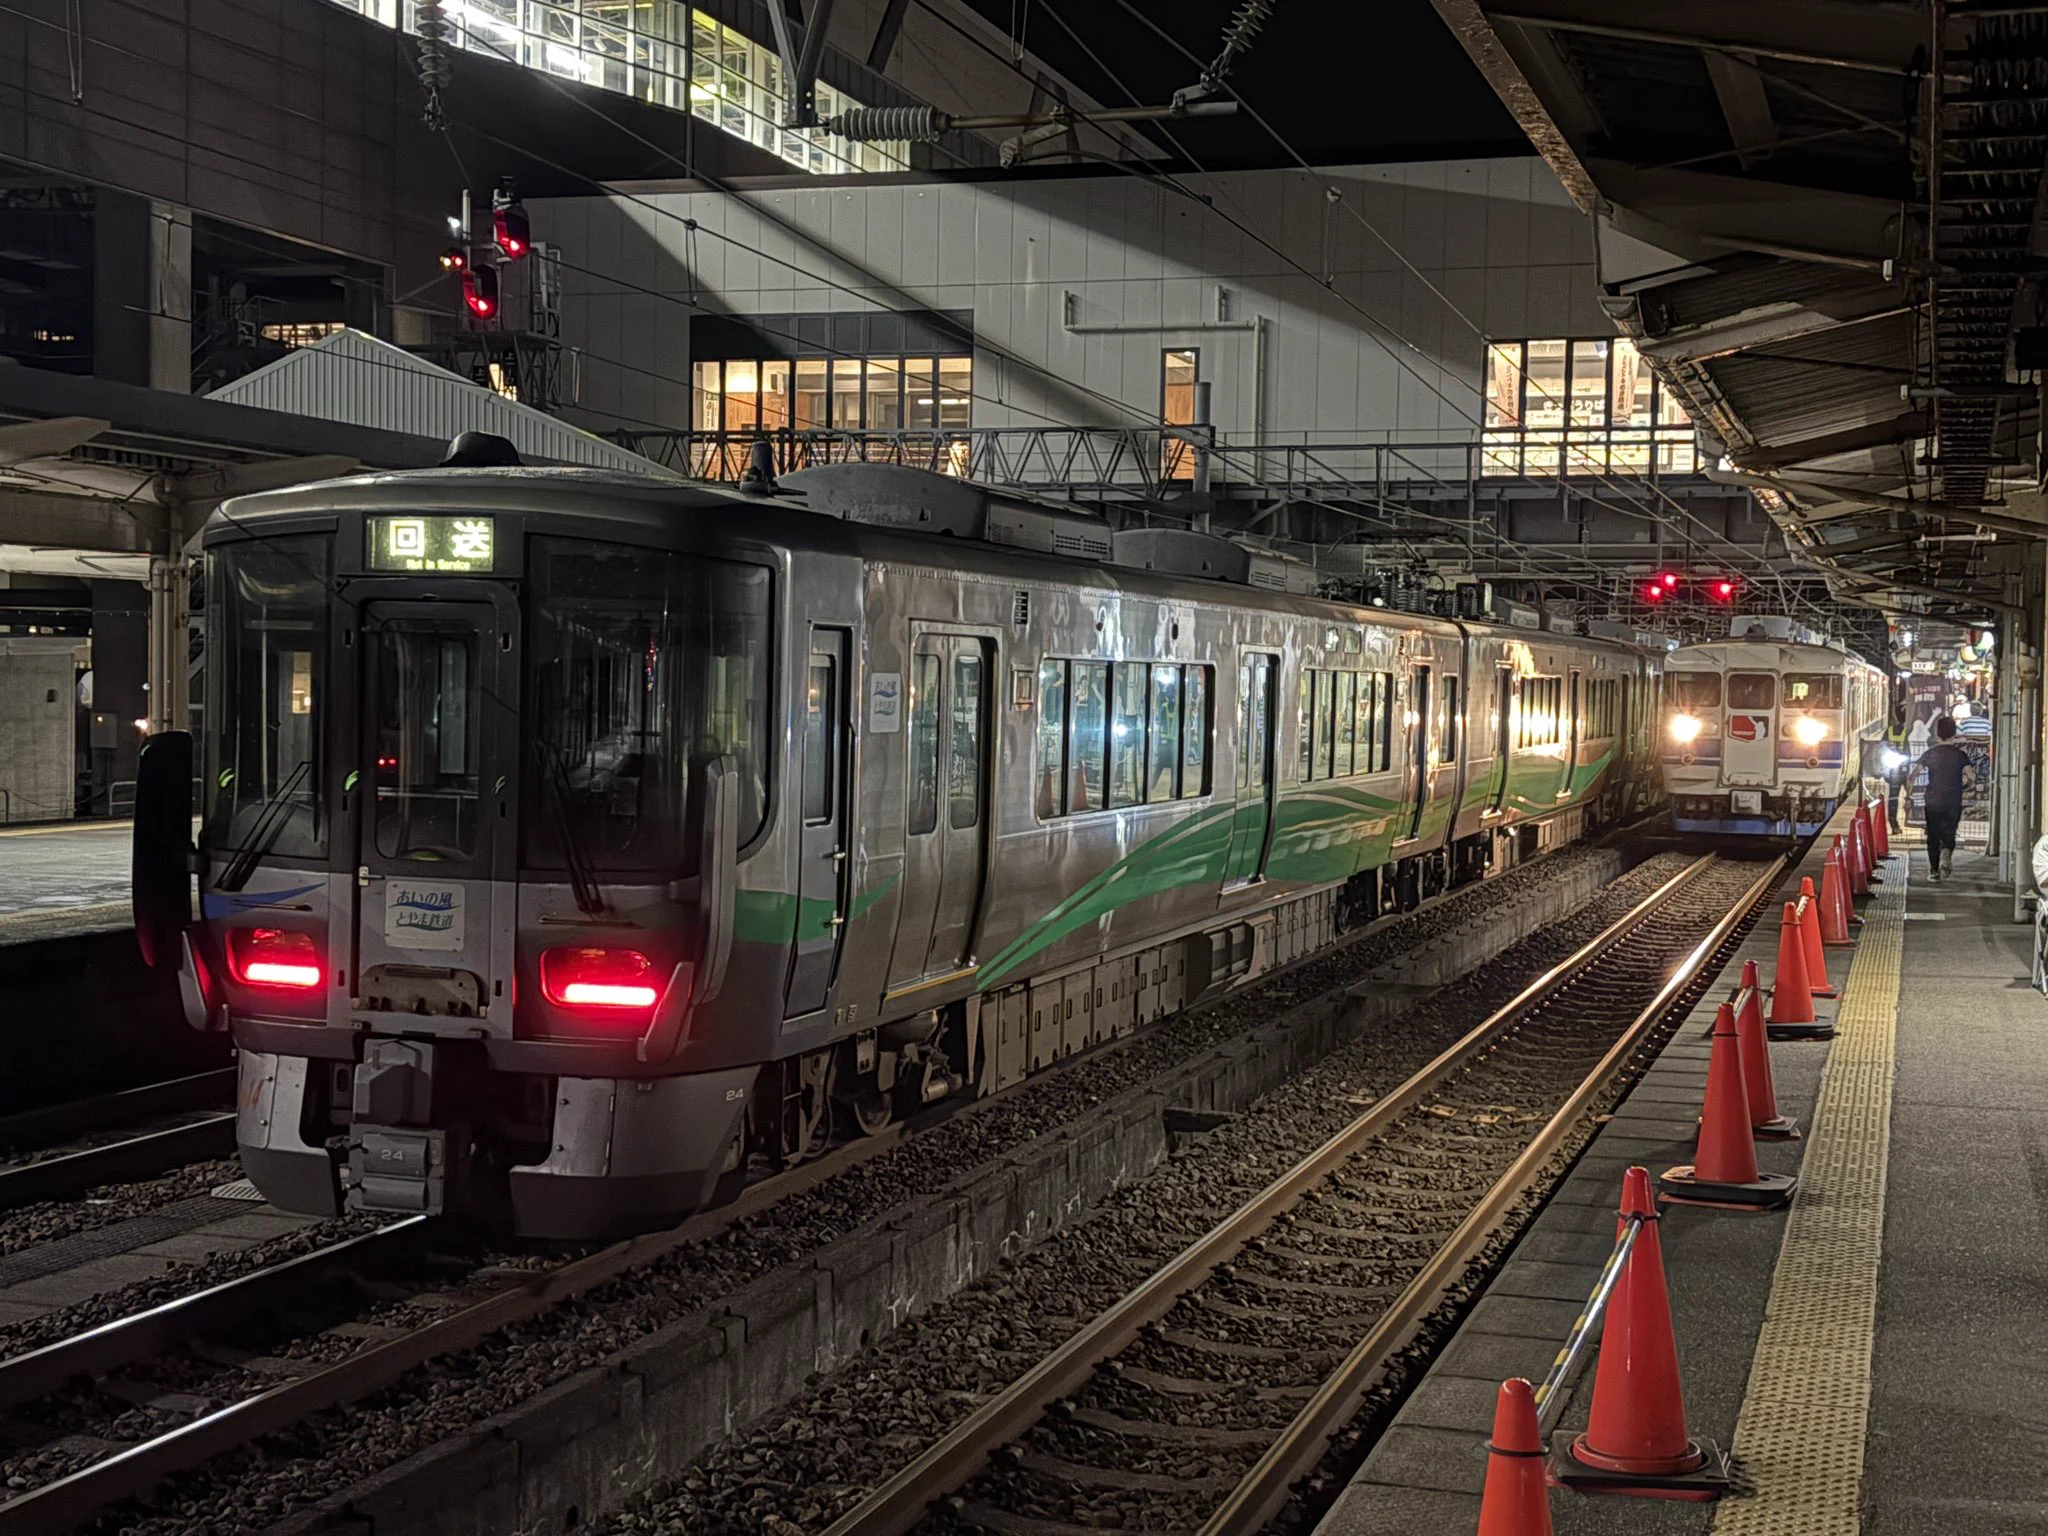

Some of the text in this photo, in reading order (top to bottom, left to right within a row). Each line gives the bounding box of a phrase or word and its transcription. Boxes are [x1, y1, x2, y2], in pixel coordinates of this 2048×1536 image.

[389, 519, 490, 558] 回送
[406, 559, 423, 571] Not
[437, 559, 471, 571] Service
[397, 889, 453, 908] あいの風
[396, 911, 455, 930] とやま鉄道
[726, 1088, 744, 1101] 24
[380, 1149, 404, 1161] 24
